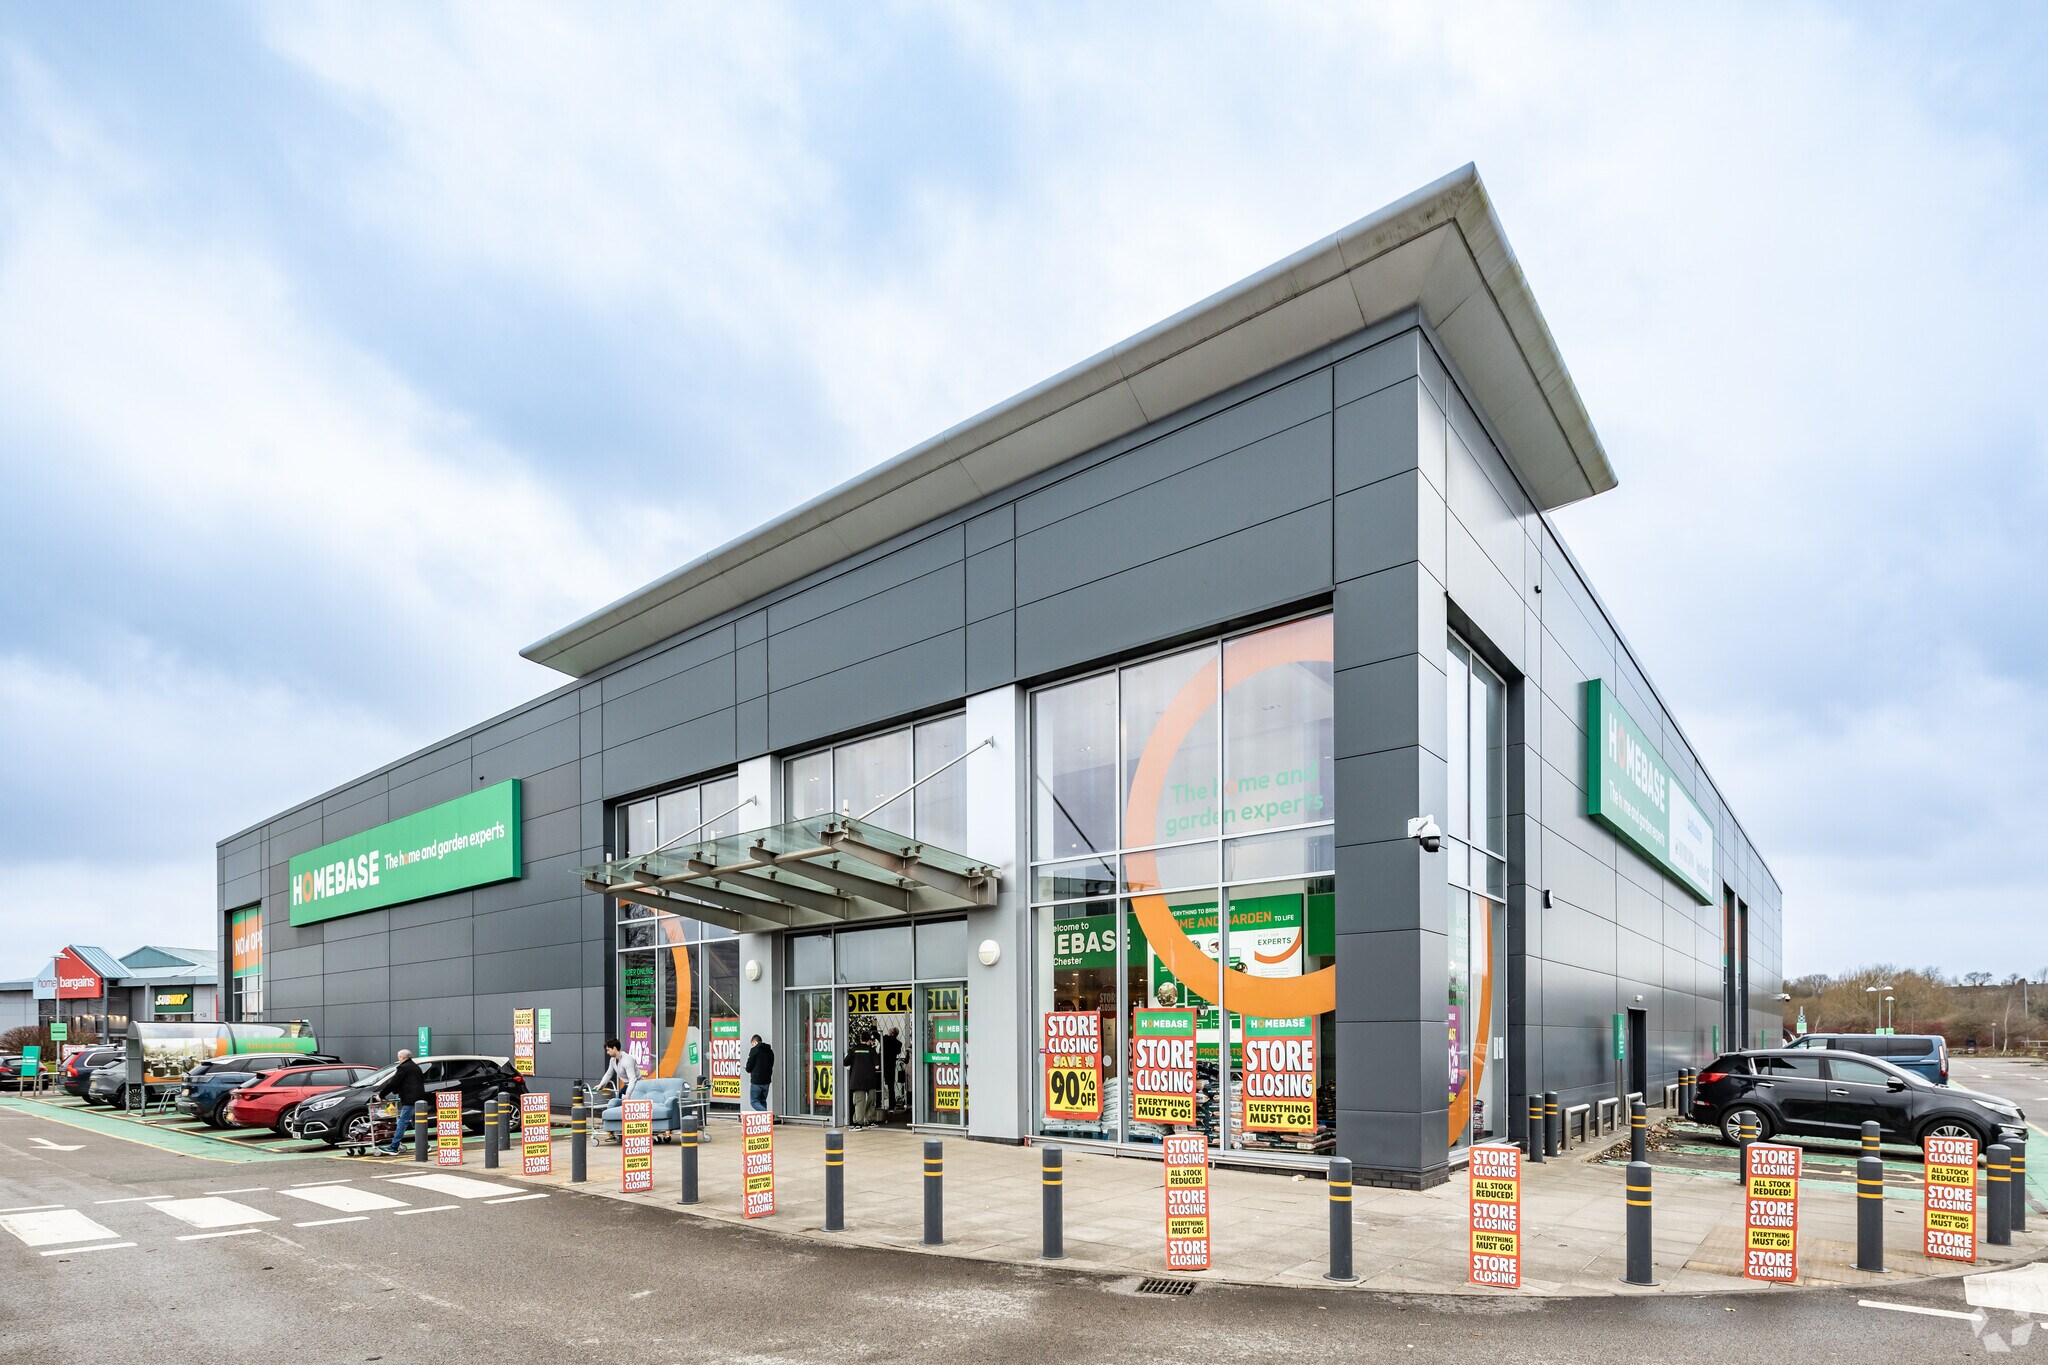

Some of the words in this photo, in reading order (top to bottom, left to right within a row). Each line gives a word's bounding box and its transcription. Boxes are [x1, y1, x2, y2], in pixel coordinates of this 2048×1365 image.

[1609, 712, 1665, 814] HOMEBASE
[1171, 783, 1208, 803] The
[1276, 763, 1318, 785] and
[1609, 779, 1618, 805] The
[1166, 807, 1235, 837] garden
[1241, 793, 1324, 822] experts
[293, 850, 379, 905] HOMEBASE
[385, 854, 398, 870] The
[400, 850, 420, 867] home
[422, 845, 437, 860] and
[438, 834, 468, 860] garden
[470, 821, 505, 848] experts
[1054, 924, 1079, 932] elcome
[1198, 916, 1218, 928] AND
[1258, 937, 1291, 945] EXPERTS
[1054, 957, 1082, 965] Chester
[38, 979, 57, 988] home
[60, 976, 95, 989] bargains
[155, 993, 188, 1005] SUBWAY
[1048, 1016, 1098, 1036] STORE
[1142, 1020, 1188, 1028] HOMEBASE
[1251, 1019, 1305, 1028] HOMEBASE
[515, 1028, 532, 1043] STORE
[515, 1044, 532, 1056] CLOSING
[713, 1040, 740, 1059] STORE
[1048, 1038, 1098, 1053] CLOSING
[1136, 1039, 1193, 1068] STORE
[1246, 1040, 1313, 1072] STORE
[1053, 1055, 1082, 1068] SAVE
[714, 1061, 740, 1076] CLOSING
[1137, 1070, 1193, 1093] CLOSING
[1247, 1074, 1313, 1098] CLOSING
[1051, 1071, 1095, 1106] 90%
[438, 1094, 458, 1102] STORE
[524, 1096, 547, 1106] STORE
[938, 1098, 958, 1106] MUST
[1081, 1093, 1096, 1106] OFF
[1138, 1098, 1190, 1107] EVERYTHING
[524, 1104, 547, 1112] CLOSING
[625, 1103, 649, 1113] STORE
[1138, 1107, 1167, 1116] MUST
[1171, 1109, 1191, 1118] GO!
[1249, 1104, 1310, 1113] EVERYTHING
[625, 1112, 649, 1121] CLOSING
[746, 1114, 770, 1127] STORE
[1250, 1113, 1283, 1123] MUST
[1288, 1115, 1311, 1125] GO!
[524, 1126, 548, 1136] STORE
[746, 1125, 771, 1135] CLOSING
[525, 1135, 548, 1143] CLOSING
[625, 1137, 650, 1147] STORE
[625, 1146, 650, 1155] CLOSING
[748, 1143, 769, 1151] REDUCED!
[1168, 1140, 1204, 1153] STORE
[1928, 1140, 1973, 1155] STORE
[440, 1149, 459, 1157] STORE
[1168, 1154, 1204, 1164] CLOSING
[1473, 1150, 1516, 1167] STORE
[1751, 1150, 1795, 1165] STORE
[1928, 1153, 1973, 1165] CLOSING
[525, 1156, 549, 1167] STORE
[747, 1153, 772, 1166] STORE
[526, 1164, 549, 1173] CLOSING
[747, 1163, 772, 1175] CLOSING
[1473, 1165, 1516, 1178] CLOSING
[1751, 1164, 1795, 1176] CLOSING
[1946, 1168, 1969, 1176] STOCK
[625, 1170, 650, 1182] STORE
[749, 1176, 770, 1184] EVERYTHING
[1171, 1177, 1202, 1185] REDUCED!
[1931, 1174, 1969, 1183] REDUCED!
[626, 1180, 650, 1189] CLOSING
[1490, 1182, 1512, 1191] STOCK
[1768, 1180, 1791, 1188] STOCK
[1169, 1190, 1206, 1204] STORE
[1476, 1189, 1513, 1200] REDUCED!
[1753, 1187, 1791, 1196] REDUCED!
[1928, 1186, 1973, 1201] STORE
[748, 1191, 772, 1206] STORE
[749, 1202, 773, 1214] CLOSING
[1169, 1204, 1206, 1215] CLOSING
[1750, 1200, 1794, 1216] STORE
[1927, 1198, 1973, 1212] CLOSING
[1473, 1203, 1517, 1220] STORE
[1931, 1213, 1969, 1222] EVERYTHING
[1473, 1218, 1516, 1232] CLOSING
[1749, 1215, 1794, 1227] CLOSING
[1931, 1219, 1952, 1227] MUST
[1955, 1221, 1969, 1229] GO!
[1476, 1235, 1513, 1243] EVERYTHING
[1753, 1231, 1790, 1239] EVERYTHING
[1927, 1231, 1972, 1248] STORE
[1170, 1241, 1207, 1254] STORE
[1476, 1242, 1497, 1250] MUST
[1500, 1243, 1514, 1251] GO!
[1752, 1238, 1774, 1246] MUST
[1927, 1244, 1972, 1258] CLOSING
[1170, 1255, 1207, 1265] CLOSING
[1473, 1255, 1516, 1272] STORE
[1749, 1251, 1793, 1266] STORE
[1473, 1270, 1516, 1284] CLOSING
[1749, 1265, 1792, 1278] CLOSING
